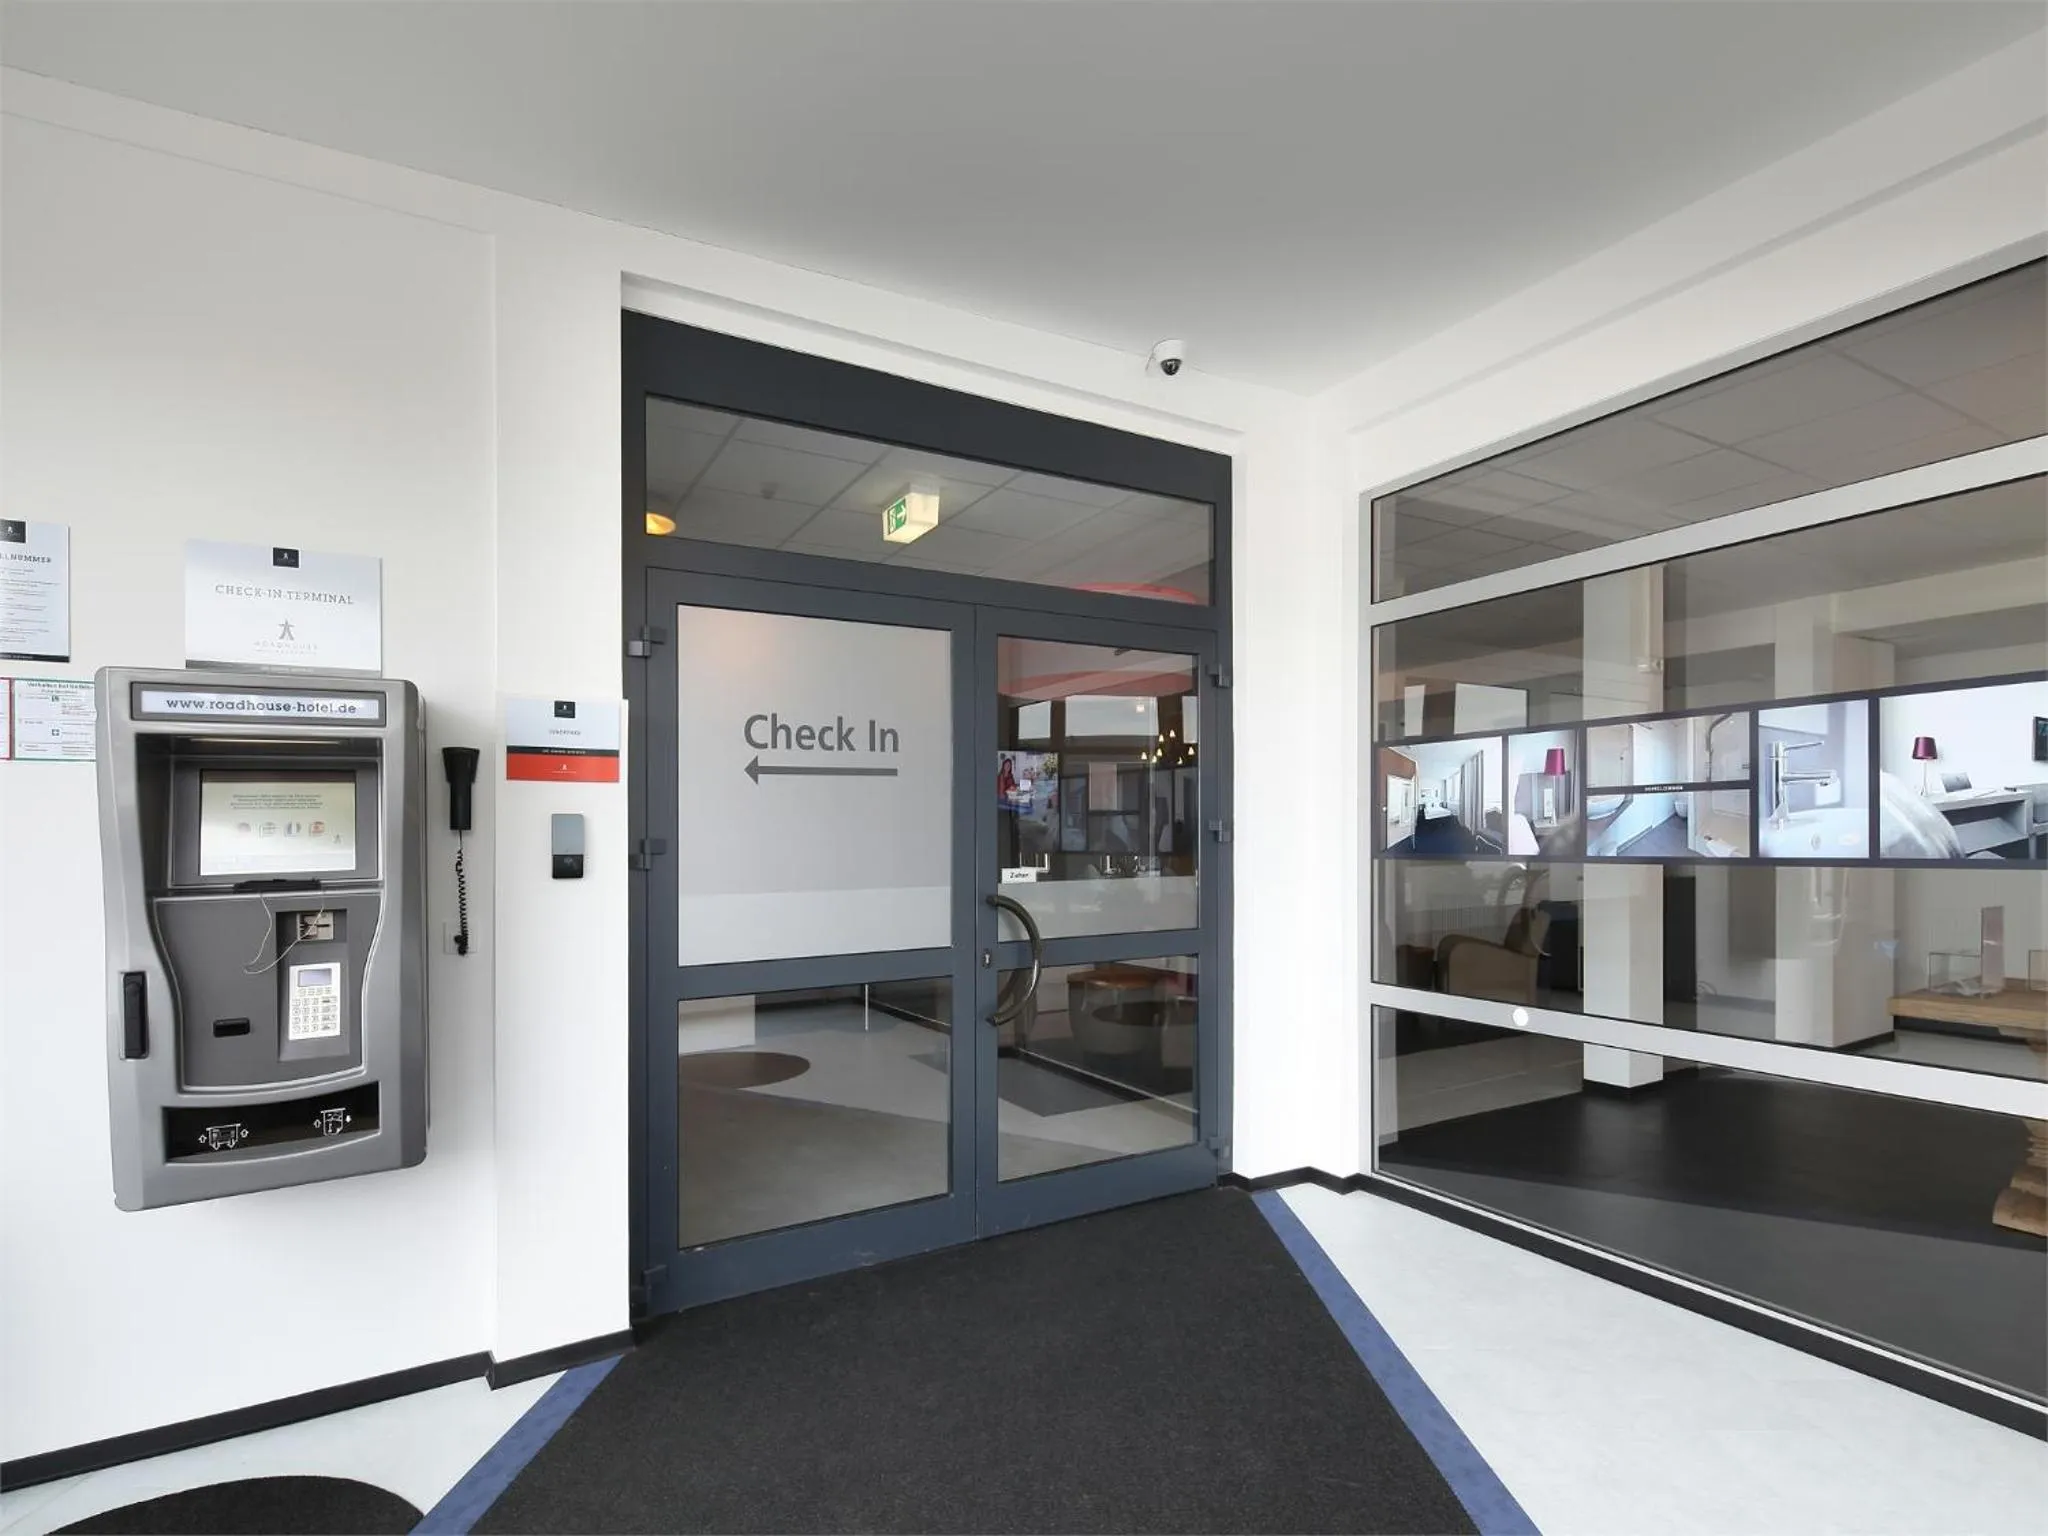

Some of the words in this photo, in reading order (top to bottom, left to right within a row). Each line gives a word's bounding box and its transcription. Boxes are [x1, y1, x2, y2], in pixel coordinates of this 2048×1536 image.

[215, 584, 282, 598] CHECK-IN
[287, 590, 354, 605] TERMINAL
[166, 698, 357, 714] www.roadhouse-hotel.de
[743, 713, 857, 752] Check
[868, 719, 899, 753] In
